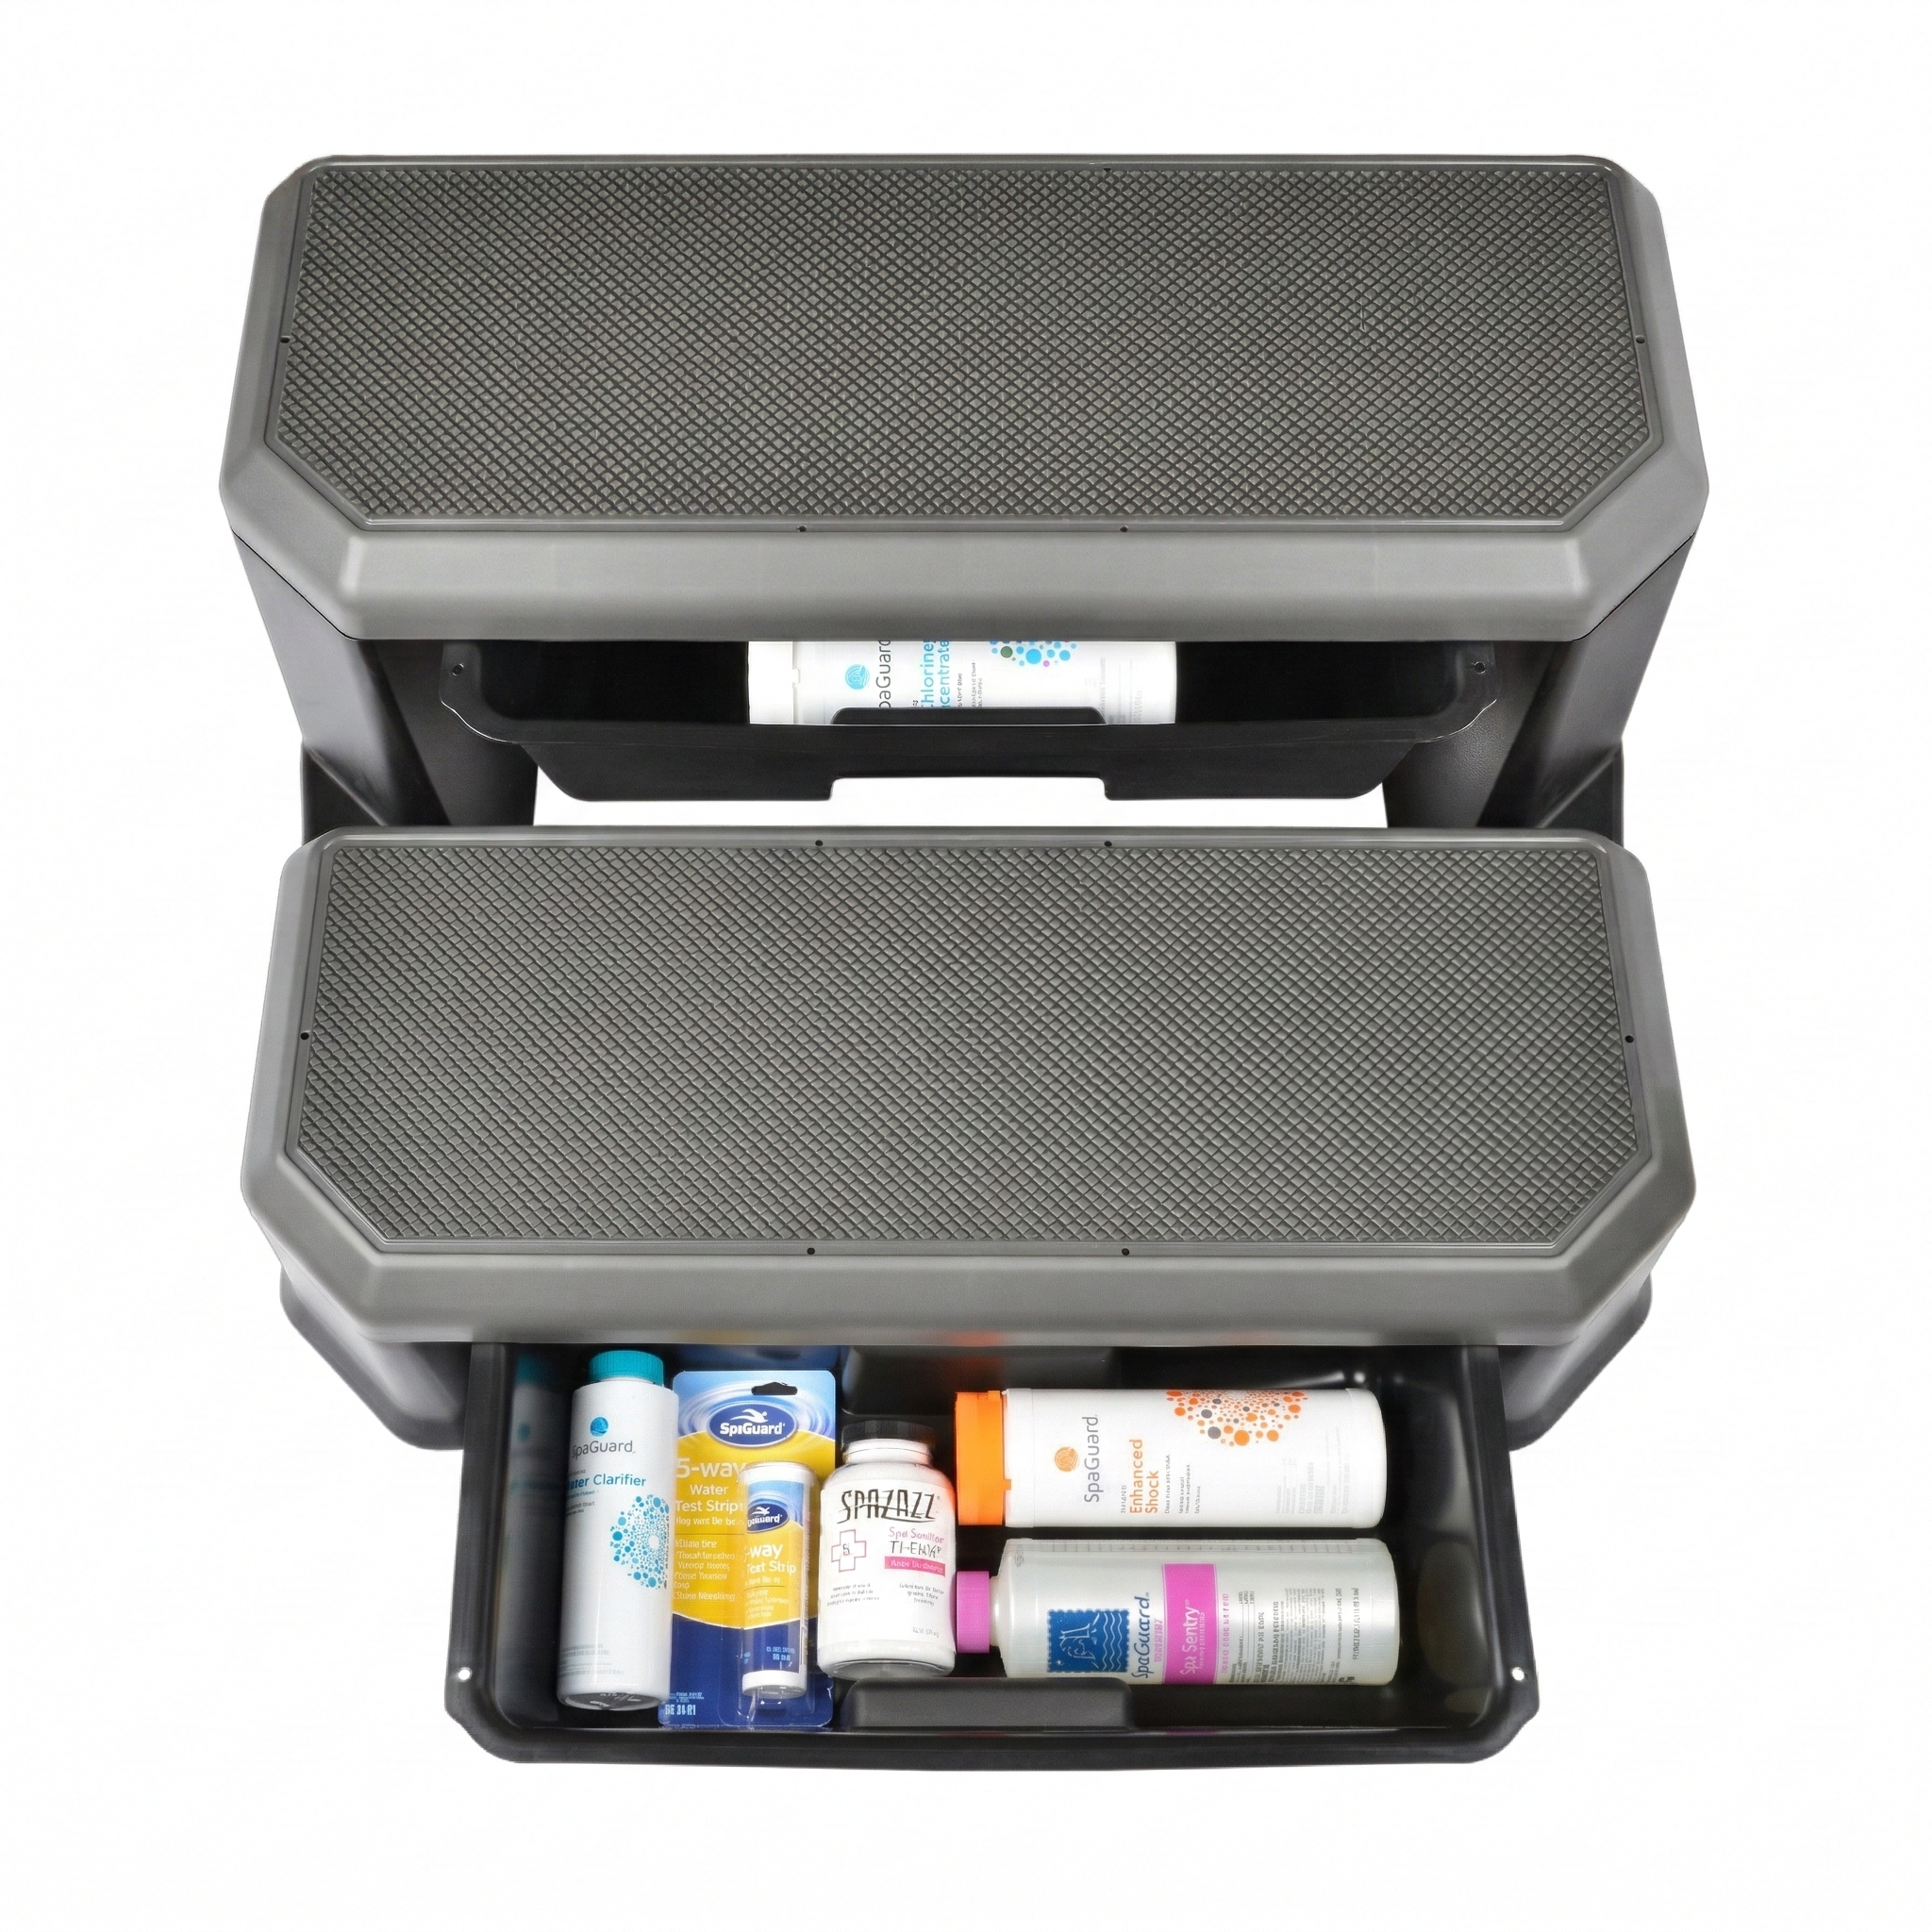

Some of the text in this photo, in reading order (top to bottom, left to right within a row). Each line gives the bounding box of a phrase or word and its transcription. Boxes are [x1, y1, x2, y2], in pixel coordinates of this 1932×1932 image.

[572, 1440, 633, 1460] SpaGuard
[1082, 1416, 1104, 1502] SpaGuard
[592, 1473, 646, 1487] Clarifier
[690, 1484, 728, 1495] Water
[1129, 1440, 1143, 1513] Enhanced
[1145, 1471, 1159, 1513] Shock
[675, 1500, 703, 1512] Test
[838, 1489, 936, 1524] SPAZAZZ
[769, 1560, 796, 1576] Strip
[1131, 1595, 1154, 1678] SpaGuard
[1180, 1607, 1199, 1675] Spa Sentry
